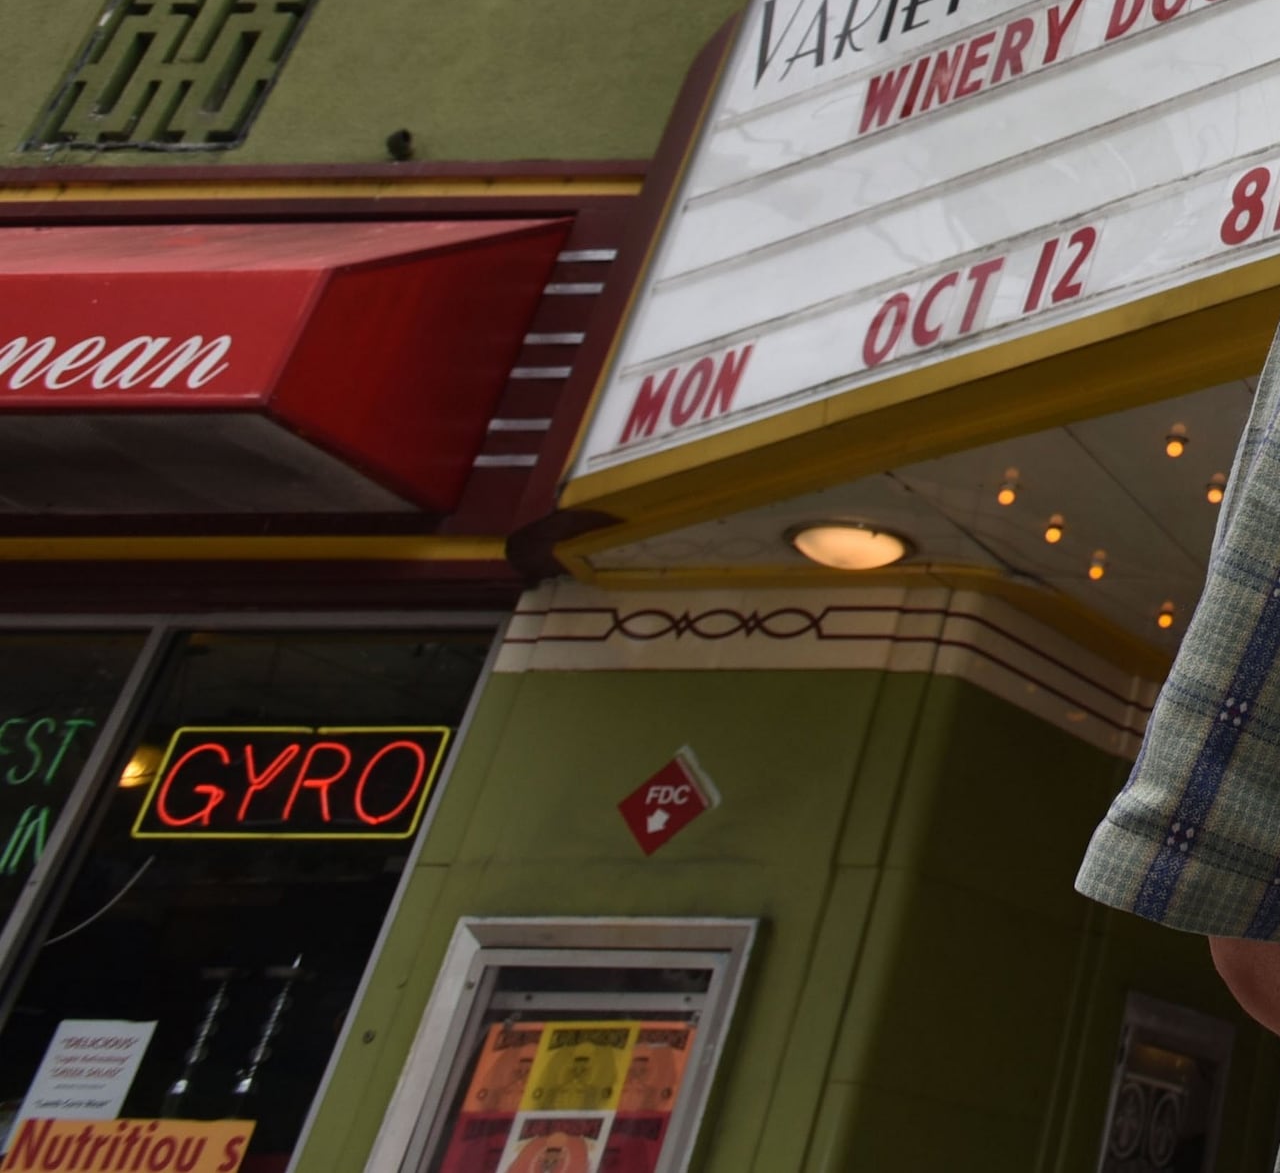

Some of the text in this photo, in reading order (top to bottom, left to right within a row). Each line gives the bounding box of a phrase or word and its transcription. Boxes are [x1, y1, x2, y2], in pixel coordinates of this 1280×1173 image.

[619, 344, 753, 444] MON
[863, 257, 1005, 367] OCT
[1024, 226, 1097, 313] 12
[156, 740, 426, 826] GYRO
[645, 785, 691, 805] FDC
